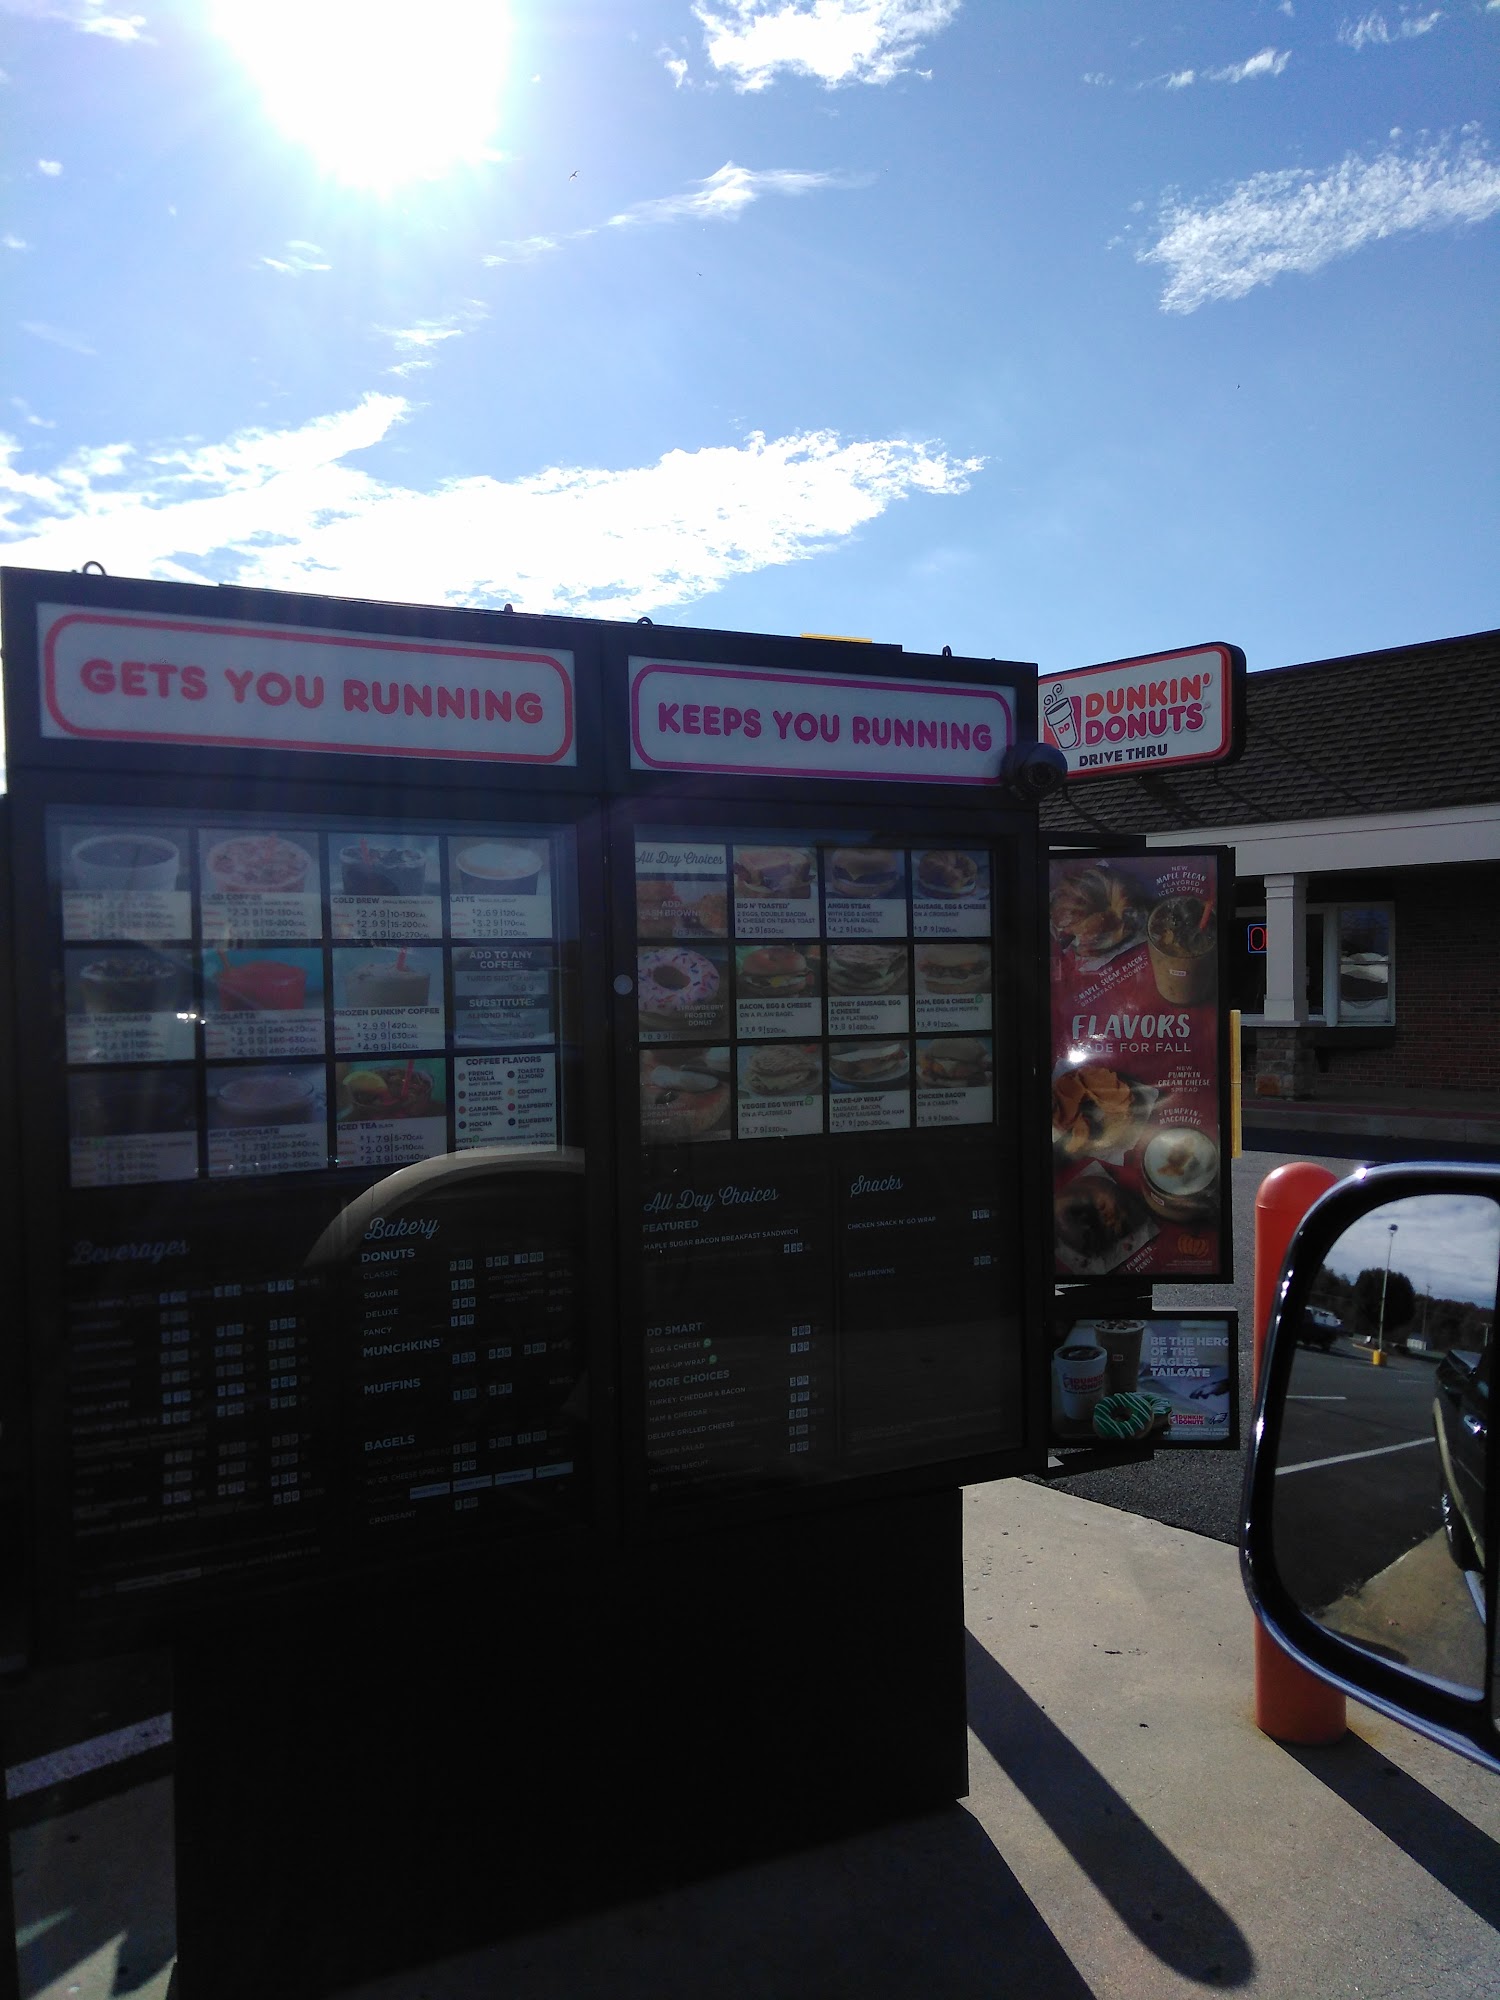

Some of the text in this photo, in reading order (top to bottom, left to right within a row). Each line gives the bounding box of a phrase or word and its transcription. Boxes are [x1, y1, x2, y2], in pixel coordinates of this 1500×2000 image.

[80, 659, 543, 724] GETS YOU RUNNING
[1085, 673, 1210, 718] DUNKIN'
[659, 702, 992, 752] KEEPS YOU RUNNING
[1058, 723, 1070, 734] DD
[1085, 703, 1203, 745] DONUTS
[1079, 744, 1168, 767] DRIVE THRU
[636, 851, 724, 867] All Day Choices
[1156, 871, 1207, 885] MAPLE PECAN
[1162, 880, 1200, 888] FLAVORED
[1158, 885, 1204, 897] ICED COFFEE
[470, 951, 532, 959] ADD TO ANY
[480, 960, 523, 969] COFFEE:
[1078, 955, 1144, 1000] MAPLE SUGAR BACON
[1099, 966, 1113, 977] NEW
[1080, 961, 1149, 1007] BREAKFAST SANDWICH
[469, 999, 534, 1007] SUBSTITUTE:
[1072, 1014, 1190, 1040] FLAVORS
[1120, 1043, 1149, 1052] FOR
[1156, 1042, 1191, 1052] FALL
[502, 1056, 541, 1064] FLAVORS
[741, 1102, 765, 1110] VEGGIE
[1164, 1108, 1198, 1117] PUMPKIN
[1159, 1116, 1201, 1125] MACCHIATO
[850, 1175, 903, 1198] Snacks
[643, 1186, 780, 1213] All Day Choices
[364, 1217, 440, 1240] Bakery
[642, 1220, 699, 1232] FEATURED
[847, 1222, 875, 1230] CHICKEN
[669, 1239, 693, 1248] SUGAR
[695, 1237, 719, 1245] BACON
[721, 1232, 760, 1242] BREAKFAST
[762, 1228, 799, 1238] SANDWICH
[72, 1240, 191, 1264] Beverages
[361, 1248, 416, 1263] DONUTS
[1126, 1246, 1153, 1271] PUMPKIN
[363, 1270, 399, 1280] CLASSIC
[849, 1267, 896, 1278] HASH BROWNS
[364, 1289, 399, 1299] SQUARE
[365, 1308, 399, 1319] DELUXE
[363, 1327, 392, 1337] FANCY
[664, 1322, 702, 1335] SMART
[363, 1338, 441, 1357] MUNCHKINS
[650, 1345, 665, 1354] EGG
[673, 1341, 700, 1350] CHEESE
[1152, 1337, 1167, 1345] BE
[1169, 1337, 1194, 1345] THE
[1152, 1347, 1195, 1355] OF THE
[648, 1358, 706, 1371] WAKE-UP WRAP
[1151, 1357, 1198, 1366] EAGLES
[1151, 1368, 1210, 1377] TAILGATE
[364, 1377, 421, 1395] MUFFINS
[648, 1370, 730, 1389] MORE CHOICES
[679, 1392, 713, 1402] CHEDDAR
[721, 1386, 746, 1395] BACON
[649, 1414, 667, 1422] HAM
[673, 1409, 708, 1419] CHEDDAR
[648, 1421, 735, 1440] DELUXE GRILLED CHEESE
[364, 1434, 416, 1452] BAGELS
[648, 1443, 705, 1457] CHICKEN SALAD
[648, 1464, 680, 1475] CHICKEN
[368, 1510, 417, 1525] CROISSANT
